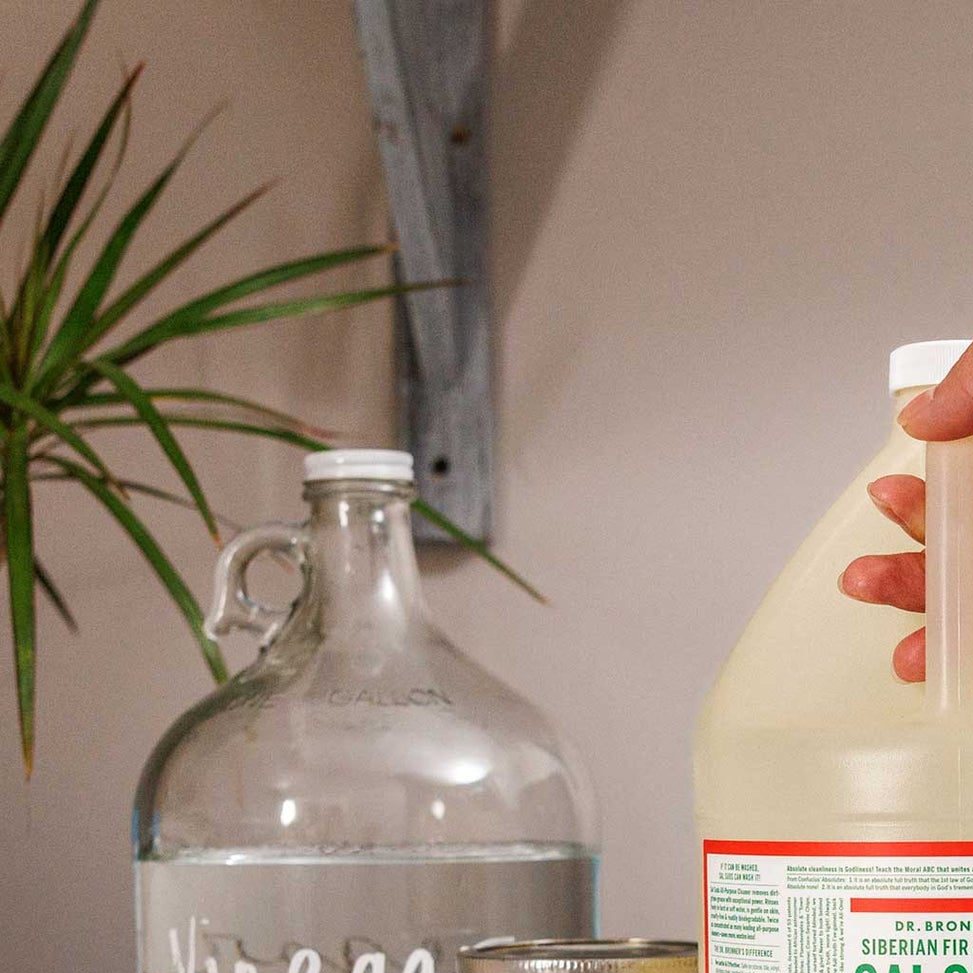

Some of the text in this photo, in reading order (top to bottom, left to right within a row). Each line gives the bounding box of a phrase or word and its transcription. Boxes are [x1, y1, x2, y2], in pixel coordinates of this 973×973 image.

[896, 921, 921, 931] DR.
[862, 938, 938, 955] SIBERIAN
[943, 939, 968, 955] FIR
